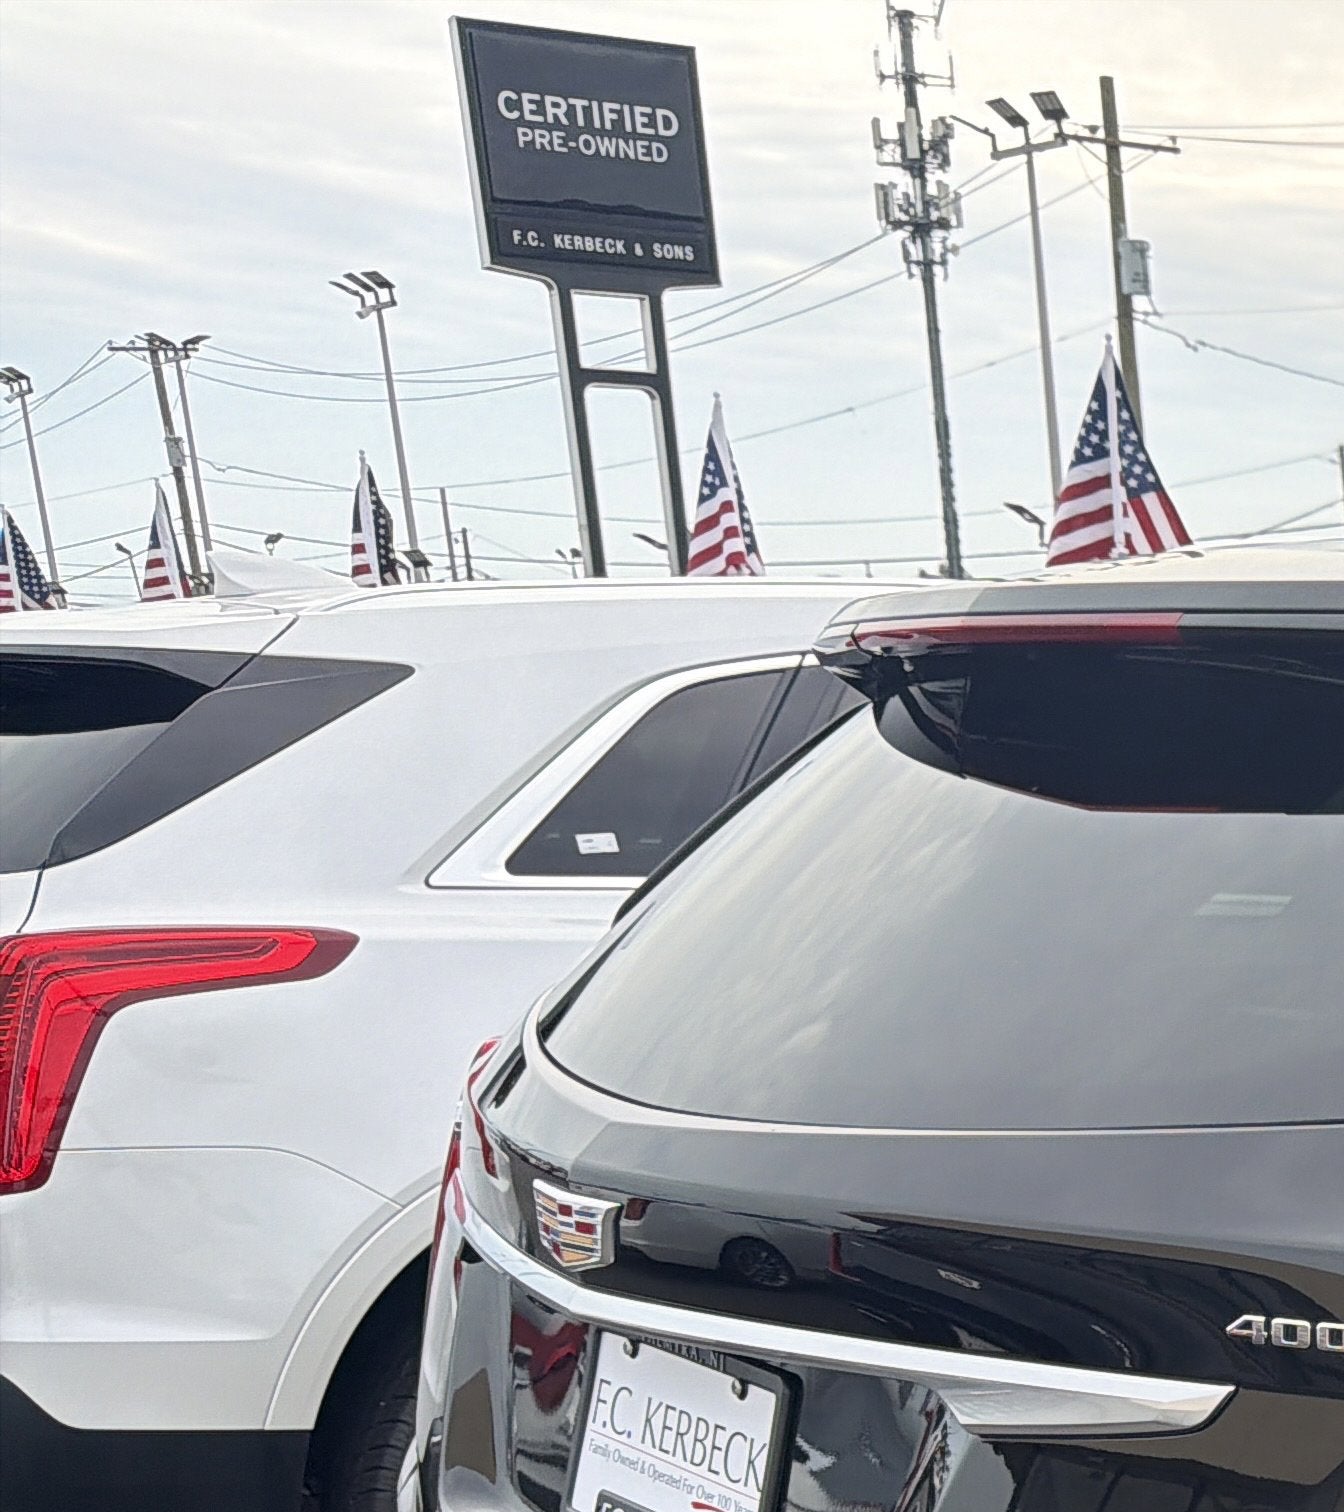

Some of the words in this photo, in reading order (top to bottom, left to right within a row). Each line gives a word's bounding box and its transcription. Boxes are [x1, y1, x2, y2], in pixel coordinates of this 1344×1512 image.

[497, 90, 679, 136] CERTIFIED
[516, 127, 669, 163] PRE-OWNED
[512, 229, 545, 247] F.C.
[553, 233, 627, 255] KERBECK
[634, 242, 644, 256] &
[653, 243, 695, 261] SONS
[591, 1378, 633, 1439] F.C.
[641, 1397, 767, 1492] KERBECK
[589, 1438, 610, 1462] Family
[612, 1448, 640, 1473] Owned
[647, 1463, 682, 1490] Operated
[682, 1476, 695, 1495] For
[696, 1485, 715, 1503] Over
[718, 1493, 732, 1511] 100
